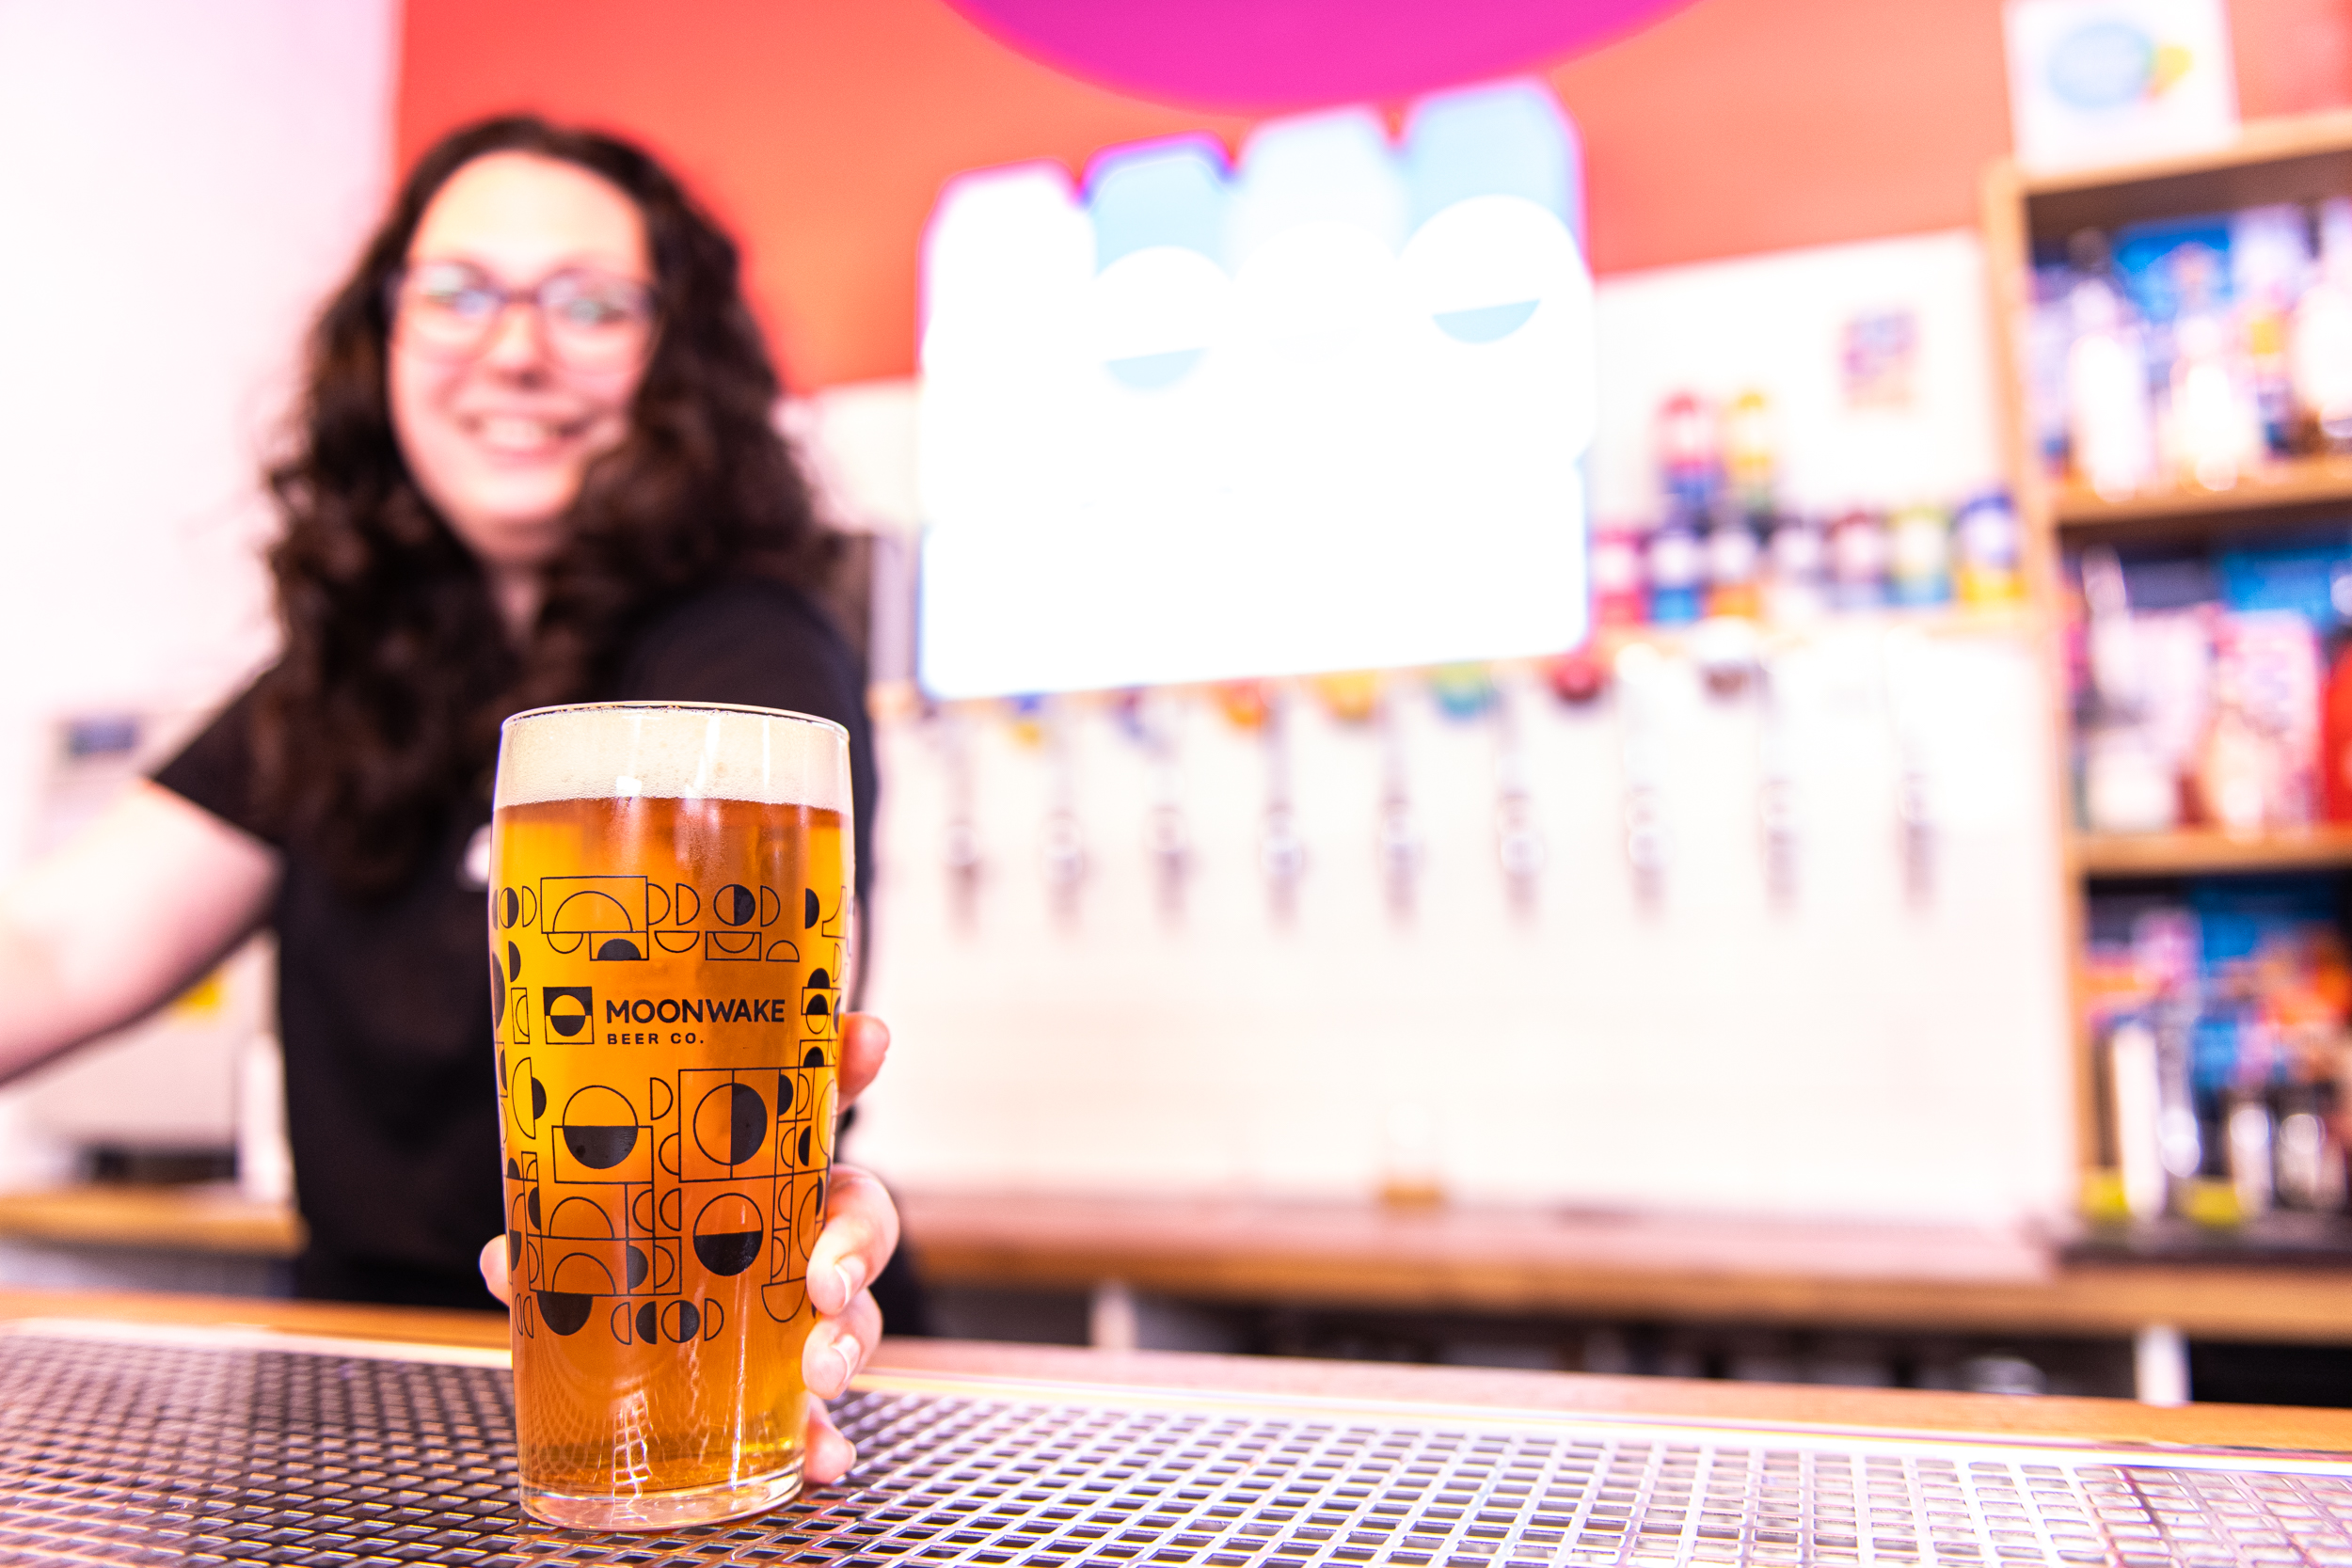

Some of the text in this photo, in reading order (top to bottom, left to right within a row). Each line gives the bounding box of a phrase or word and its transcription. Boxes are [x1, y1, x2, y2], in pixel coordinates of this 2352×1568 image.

[606, 998, 786, 1023] MOONWAKE
[607, 1032, 704, 1045] BEER CO.
